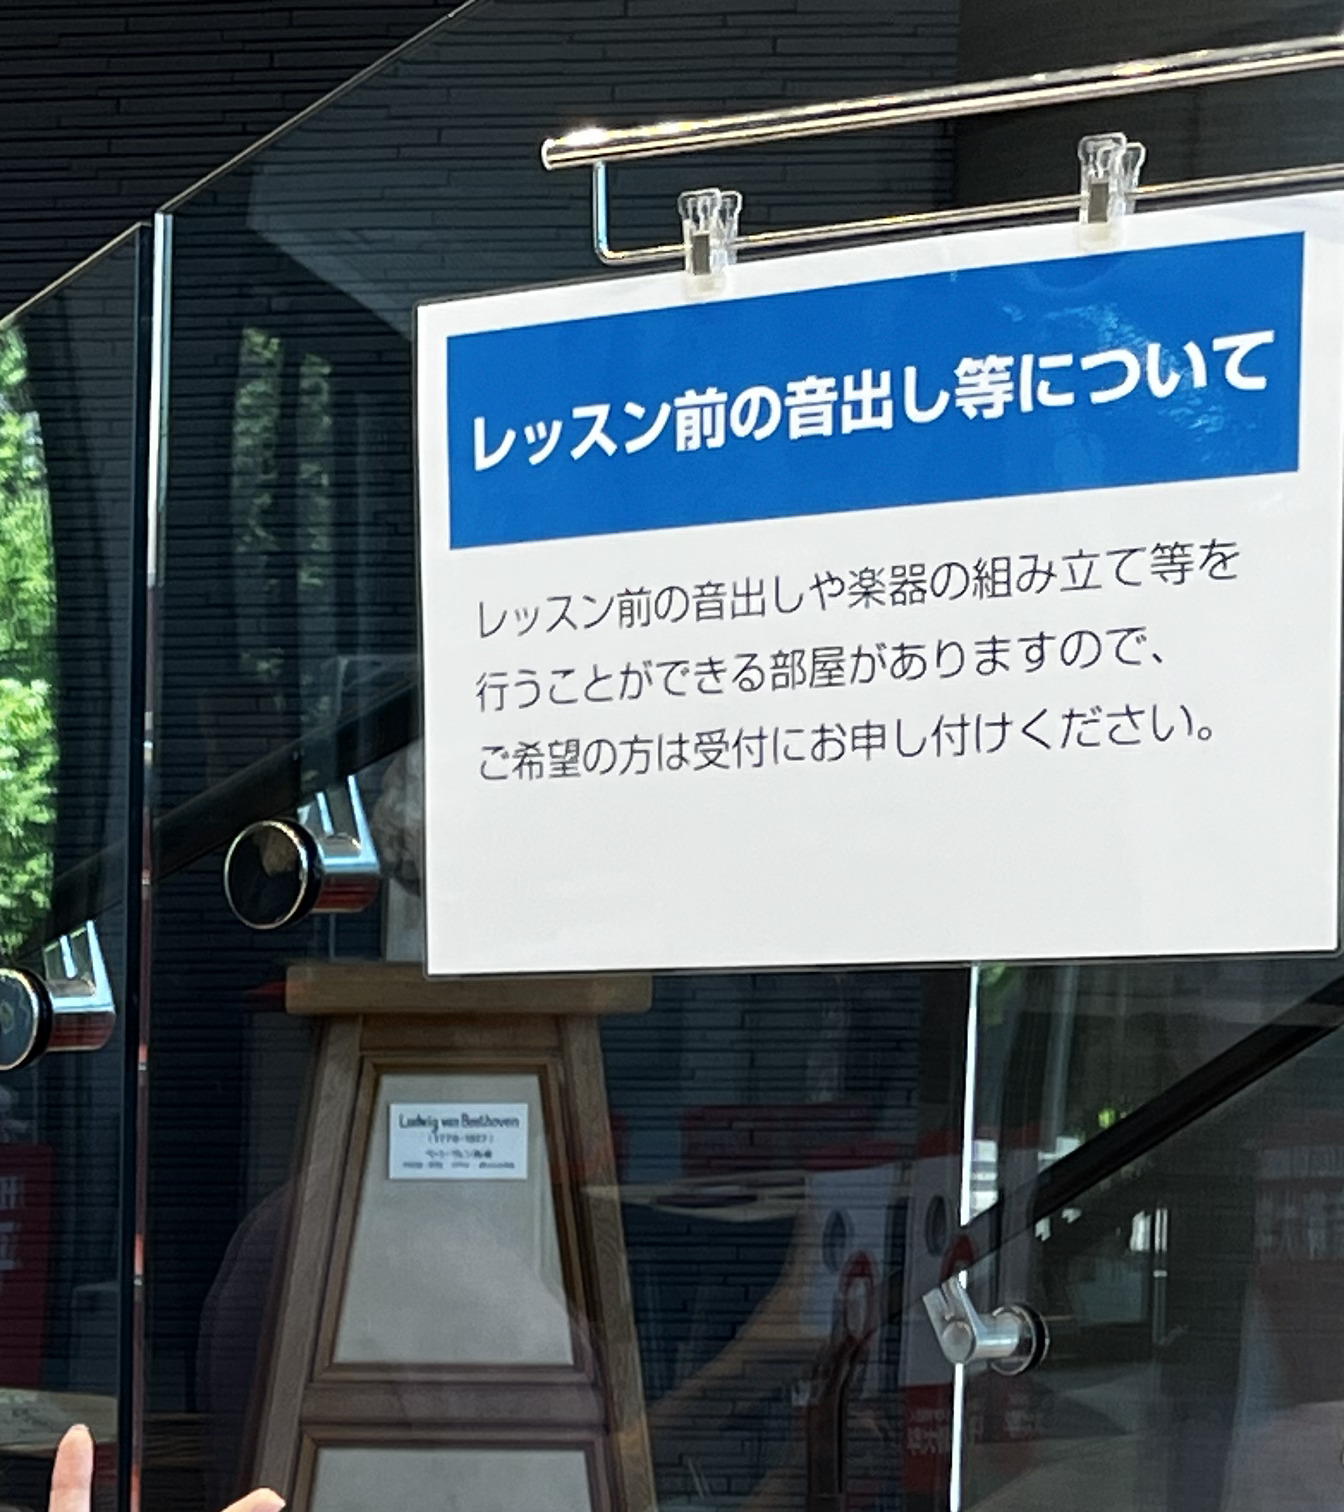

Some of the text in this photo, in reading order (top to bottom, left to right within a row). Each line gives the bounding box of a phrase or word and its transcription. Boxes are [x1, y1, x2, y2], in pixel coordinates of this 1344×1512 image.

[473, 329, 1275, 472] レッスン前の音出し等について
[478, 537, 1241, 639] レッスン前の音出しや楽器の組み立て等を
[475, 625, 1164, 713] 行うことができる部屋がありますので、
[479, 703, 1213, 781] ご希望の方は受付にお申し付けください。
